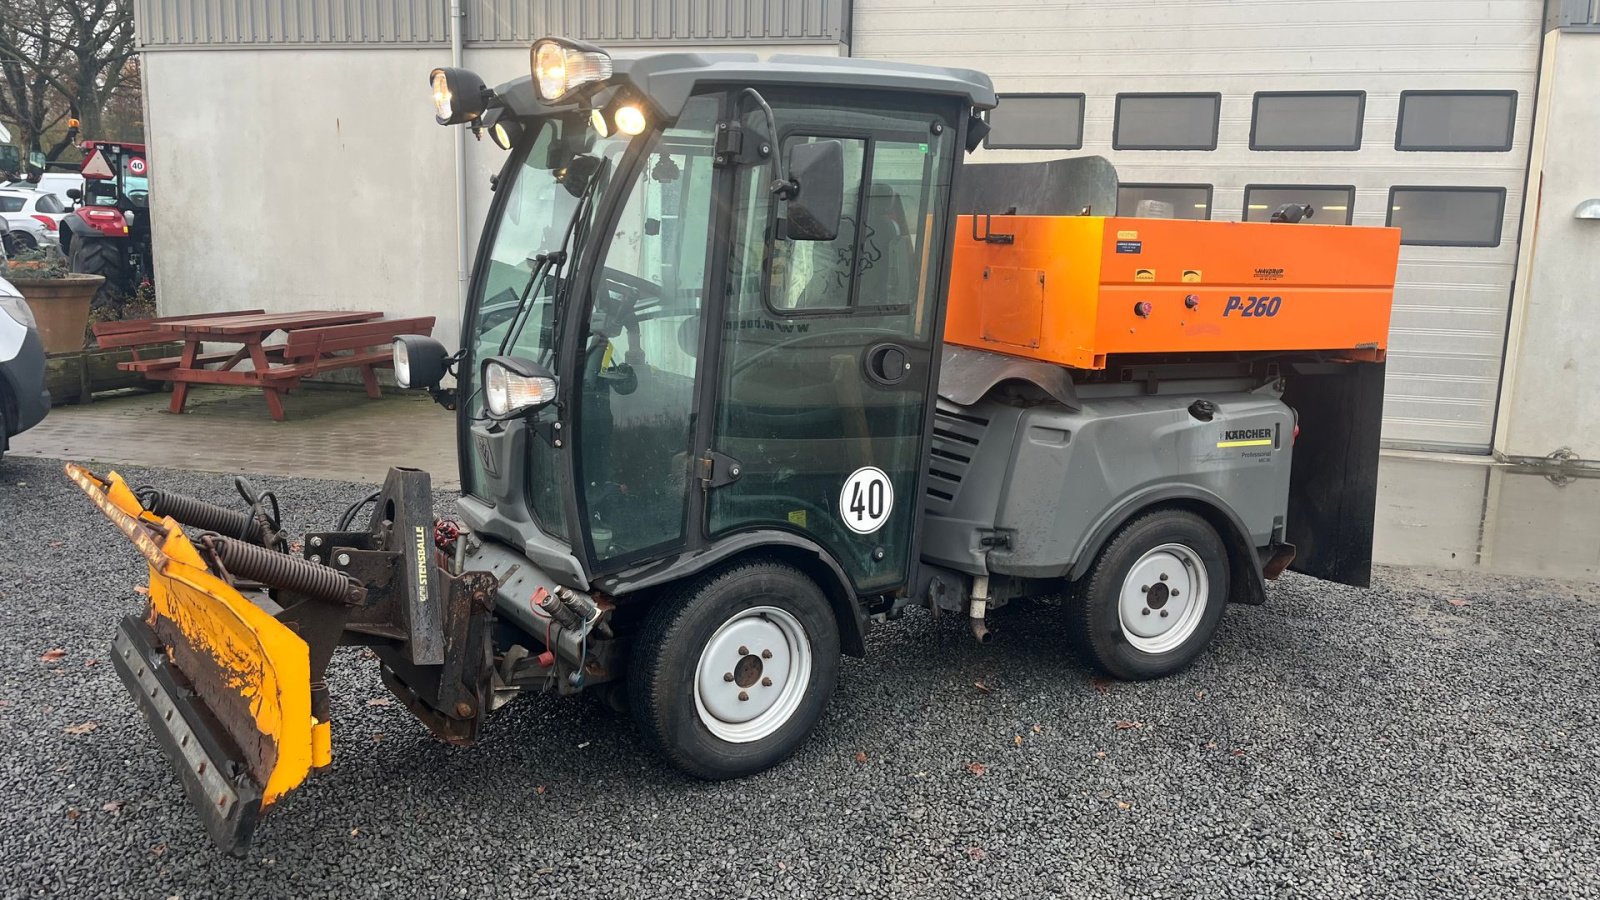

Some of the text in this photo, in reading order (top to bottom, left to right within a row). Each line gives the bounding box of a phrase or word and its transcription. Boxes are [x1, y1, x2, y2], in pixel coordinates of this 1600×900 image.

[132, 162, 142, 170] 40
[1223, 296, 1282, 317] P-260
[1225, 428, 1272, 440] KÄRCHER
[850, 479, 884, 521] 40
[415, 526, 427, 585] STENSBALLE
